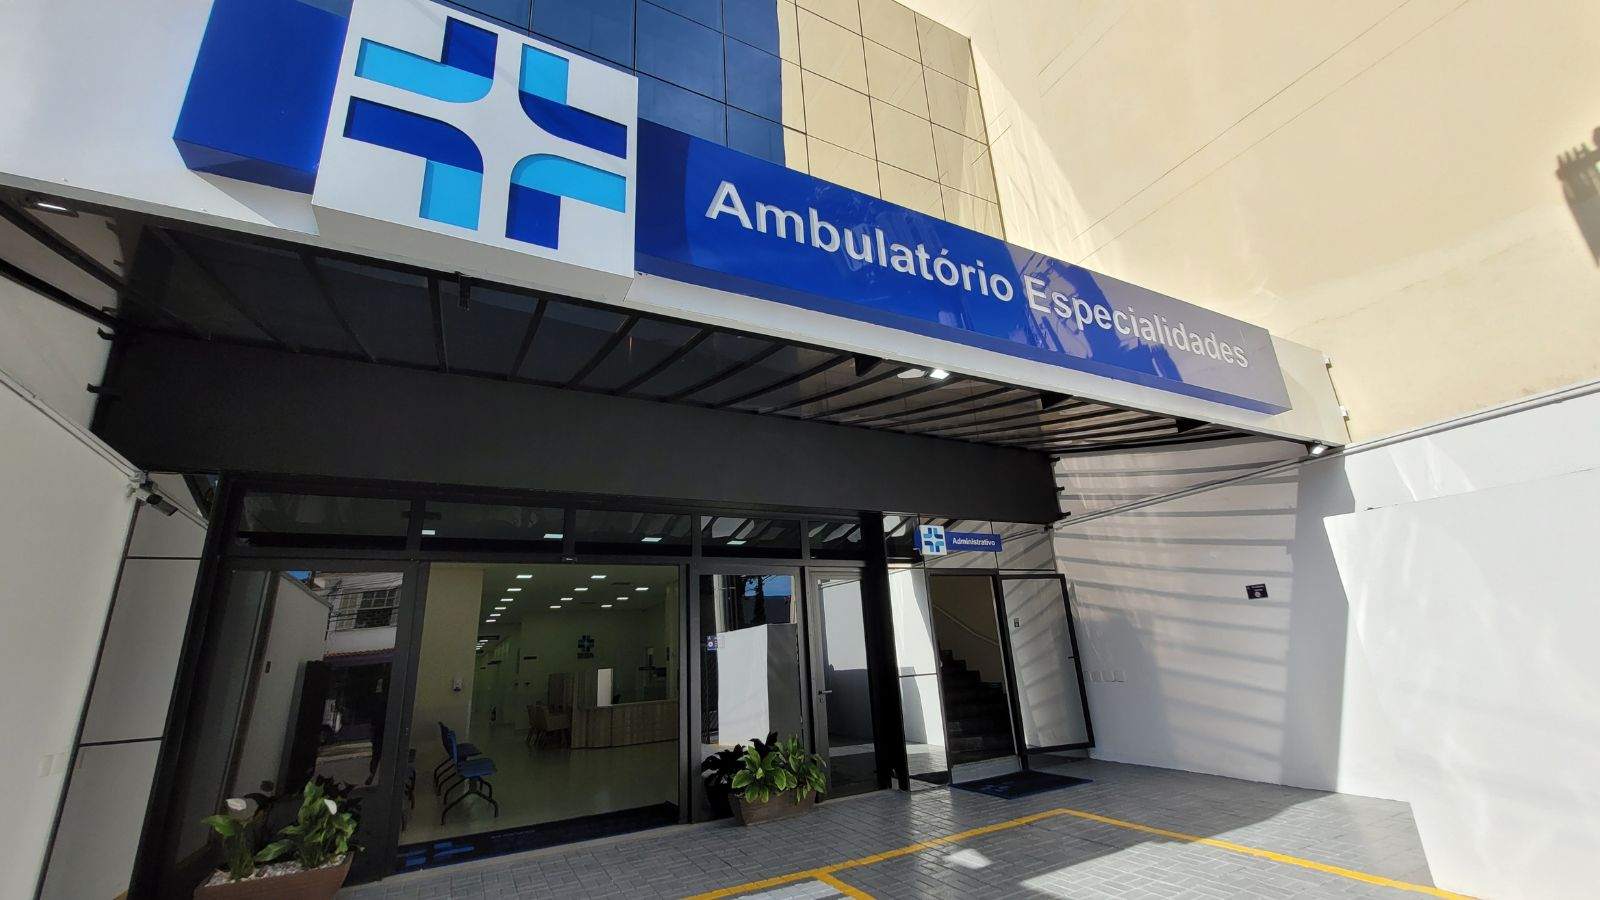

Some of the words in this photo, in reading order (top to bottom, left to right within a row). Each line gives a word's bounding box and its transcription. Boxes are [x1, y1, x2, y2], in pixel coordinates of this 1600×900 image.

[705, 181, 1014, 302] Ambulatório
[1025, 275, 1249, 369] Especialidades
[952, 537, 996, 547] Administrativo
